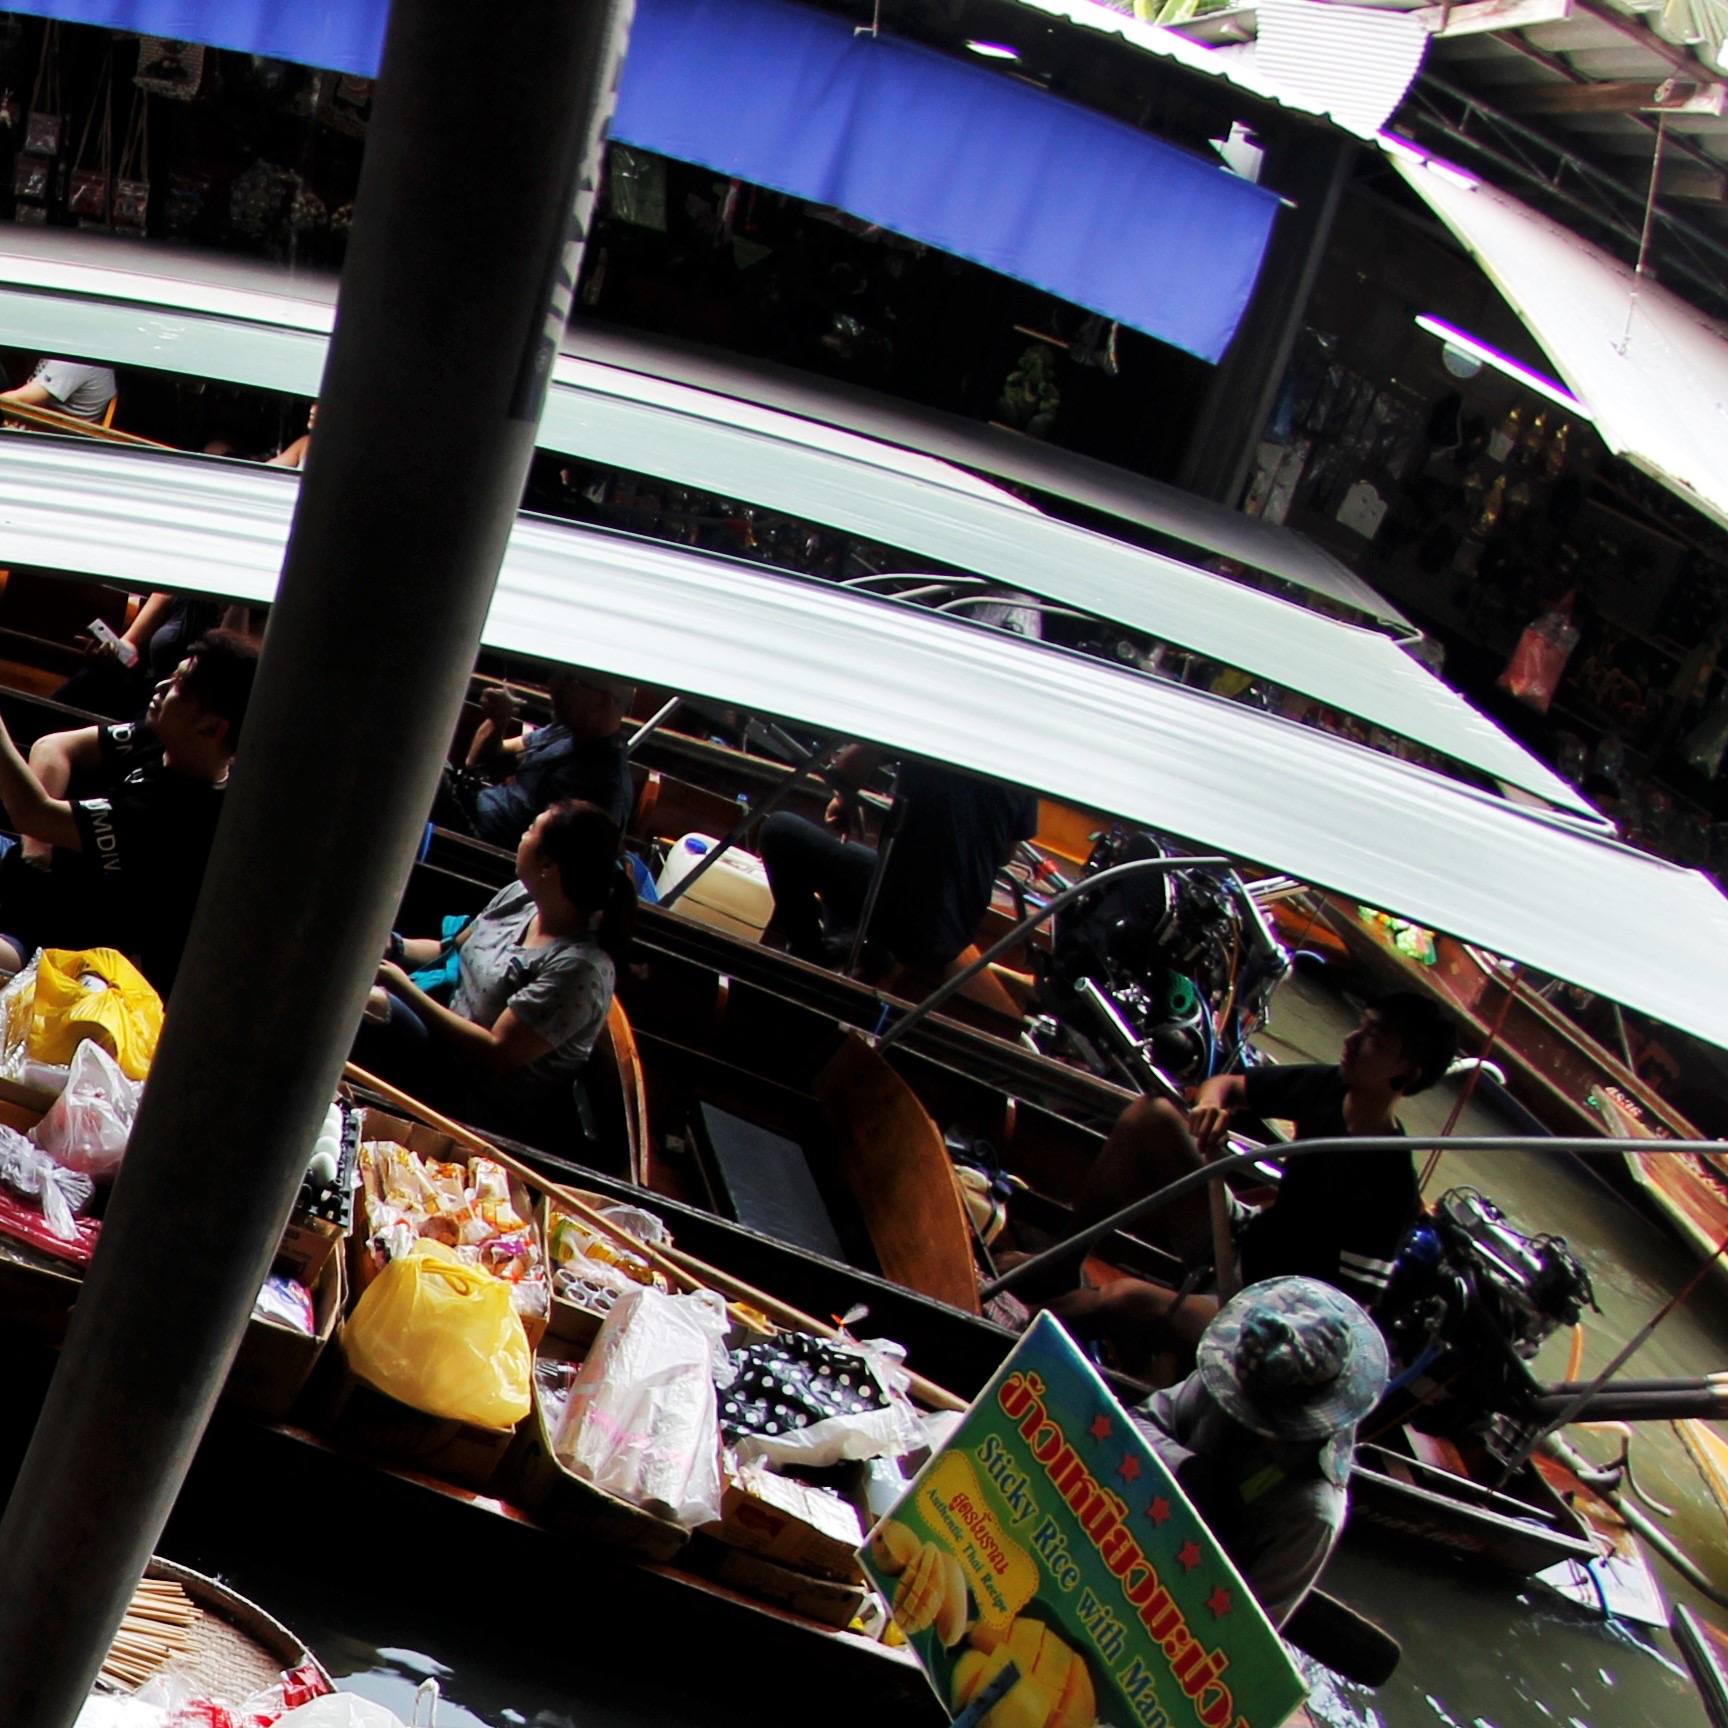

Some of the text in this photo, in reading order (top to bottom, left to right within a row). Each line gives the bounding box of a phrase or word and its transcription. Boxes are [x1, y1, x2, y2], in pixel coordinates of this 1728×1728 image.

[926, 1487, 1008, 1615] Authentic Thai Recipe
[975, 1432, 1036, 1525] Sticky
[1032, 1521, 1083, 1593] Rice
[1076, 1586, 1125, 1664] with
